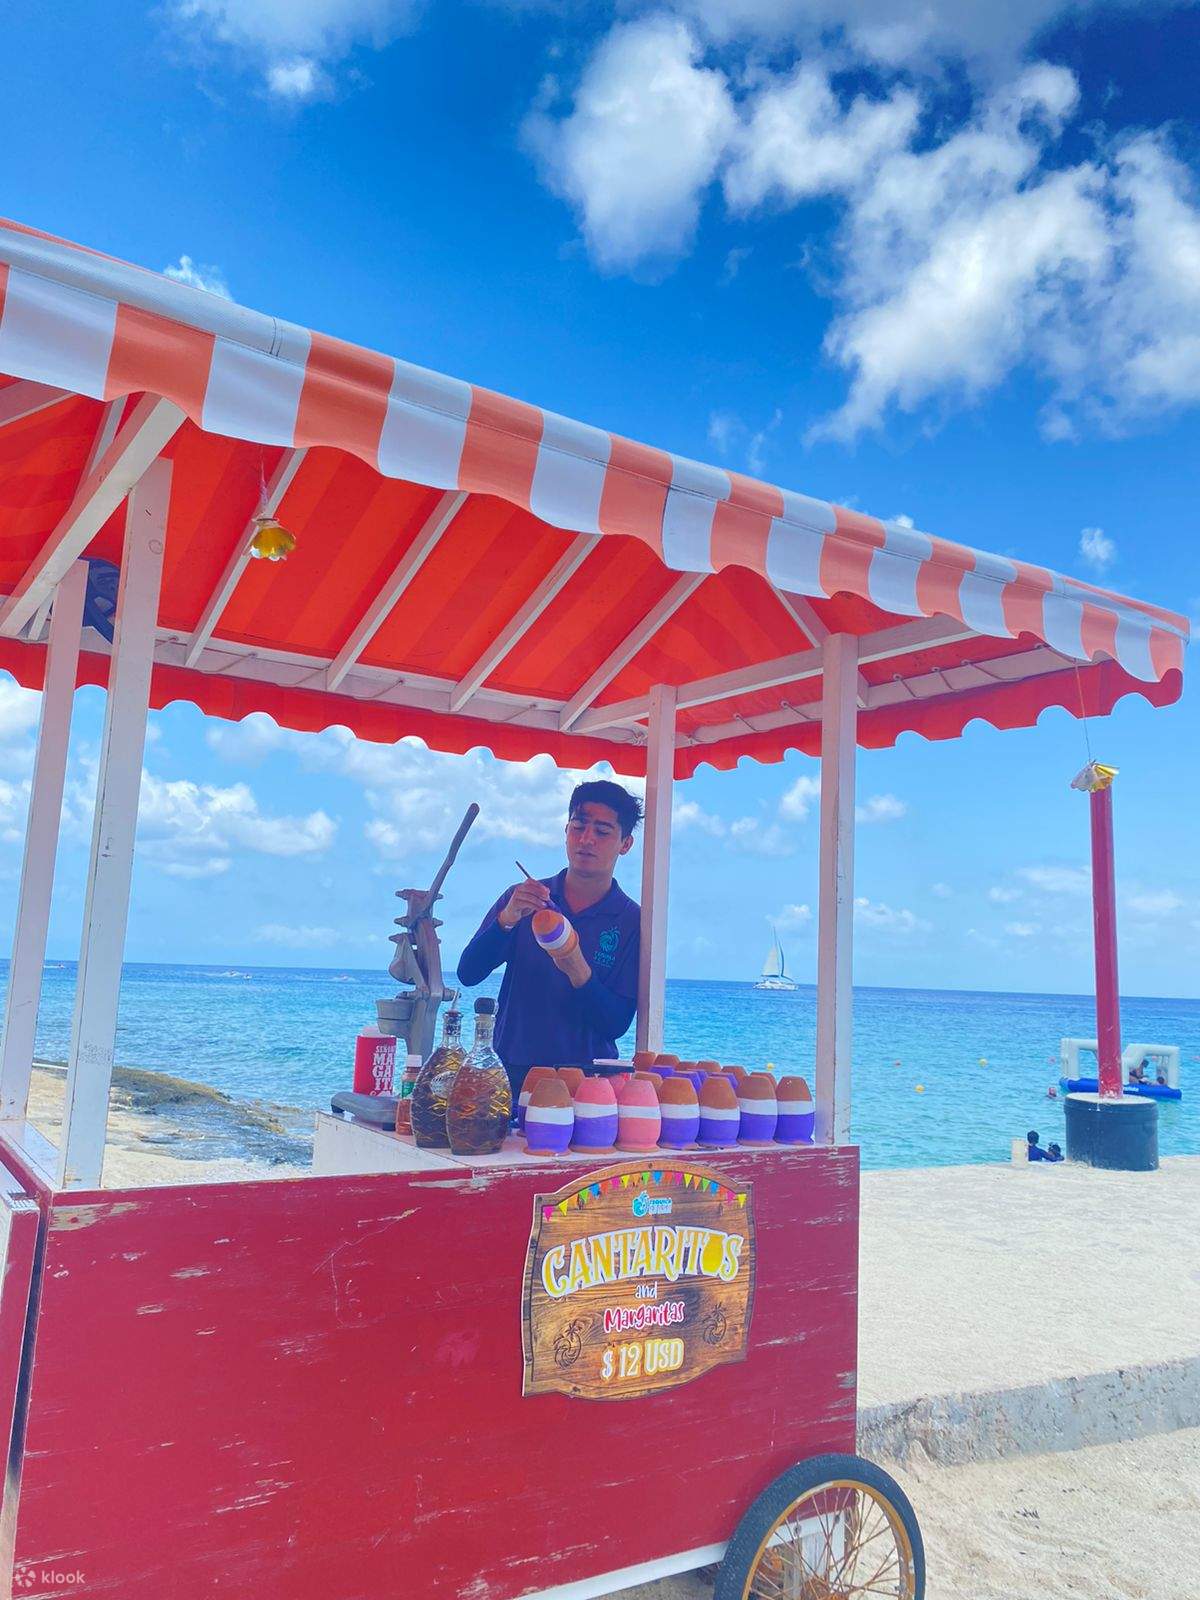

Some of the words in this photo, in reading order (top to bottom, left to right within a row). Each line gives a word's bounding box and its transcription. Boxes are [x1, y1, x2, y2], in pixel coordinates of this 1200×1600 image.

[541, 1226, 744, 1297] CANTARITOS
[635, 1281, 657, 1299] and
[604, 1301, 685, 1333] Margaritas
[602, 1349, 614, 1379] $
[619, 1343, 641, 1378] 12
[645, 1340, 684, 1374] USD
